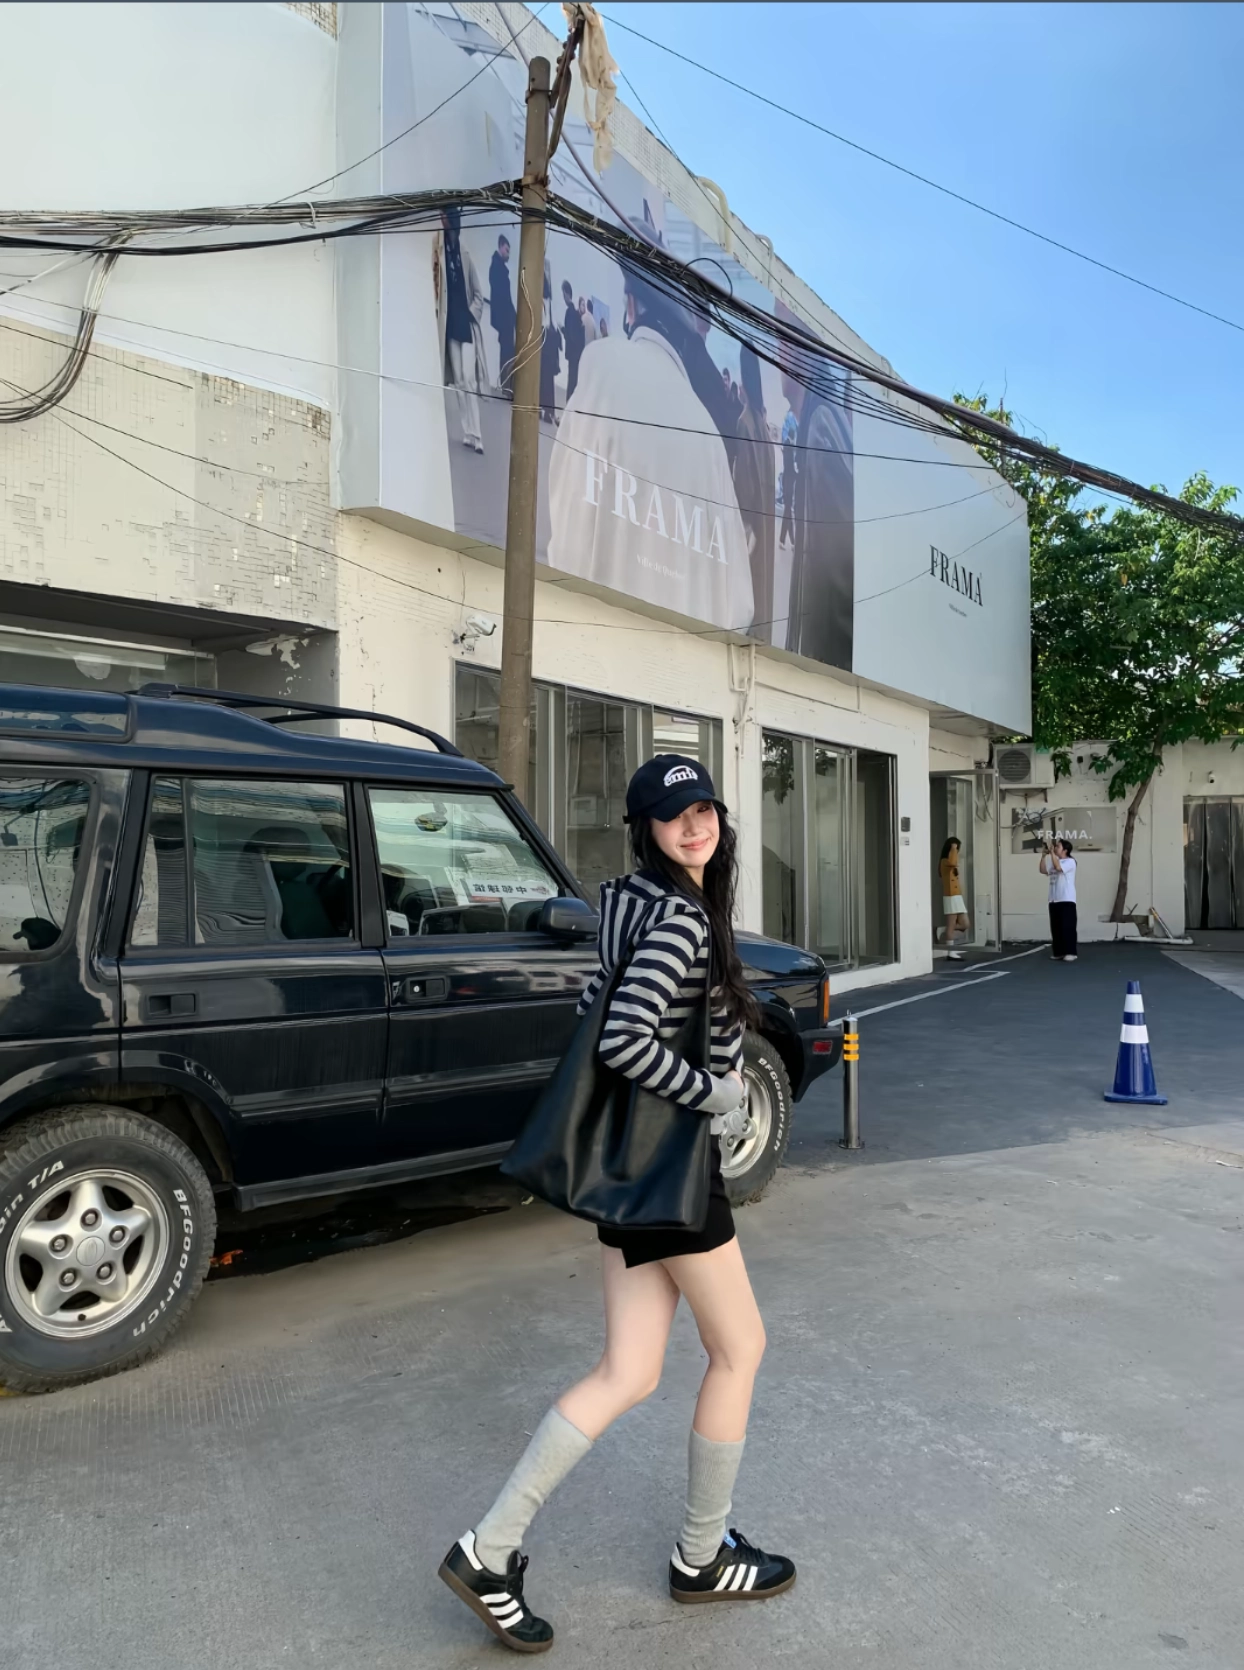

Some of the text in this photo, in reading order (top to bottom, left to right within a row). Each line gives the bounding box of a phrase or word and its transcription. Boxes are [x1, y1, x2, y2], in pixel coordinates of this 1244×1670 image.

[583, 447, 729, 566] FRAMA
[929, 544, 984, 607] FRAMA
[27, 1160, 65, 1190] T/A
[132, 1189, 194, 1337] BFGoodrich
